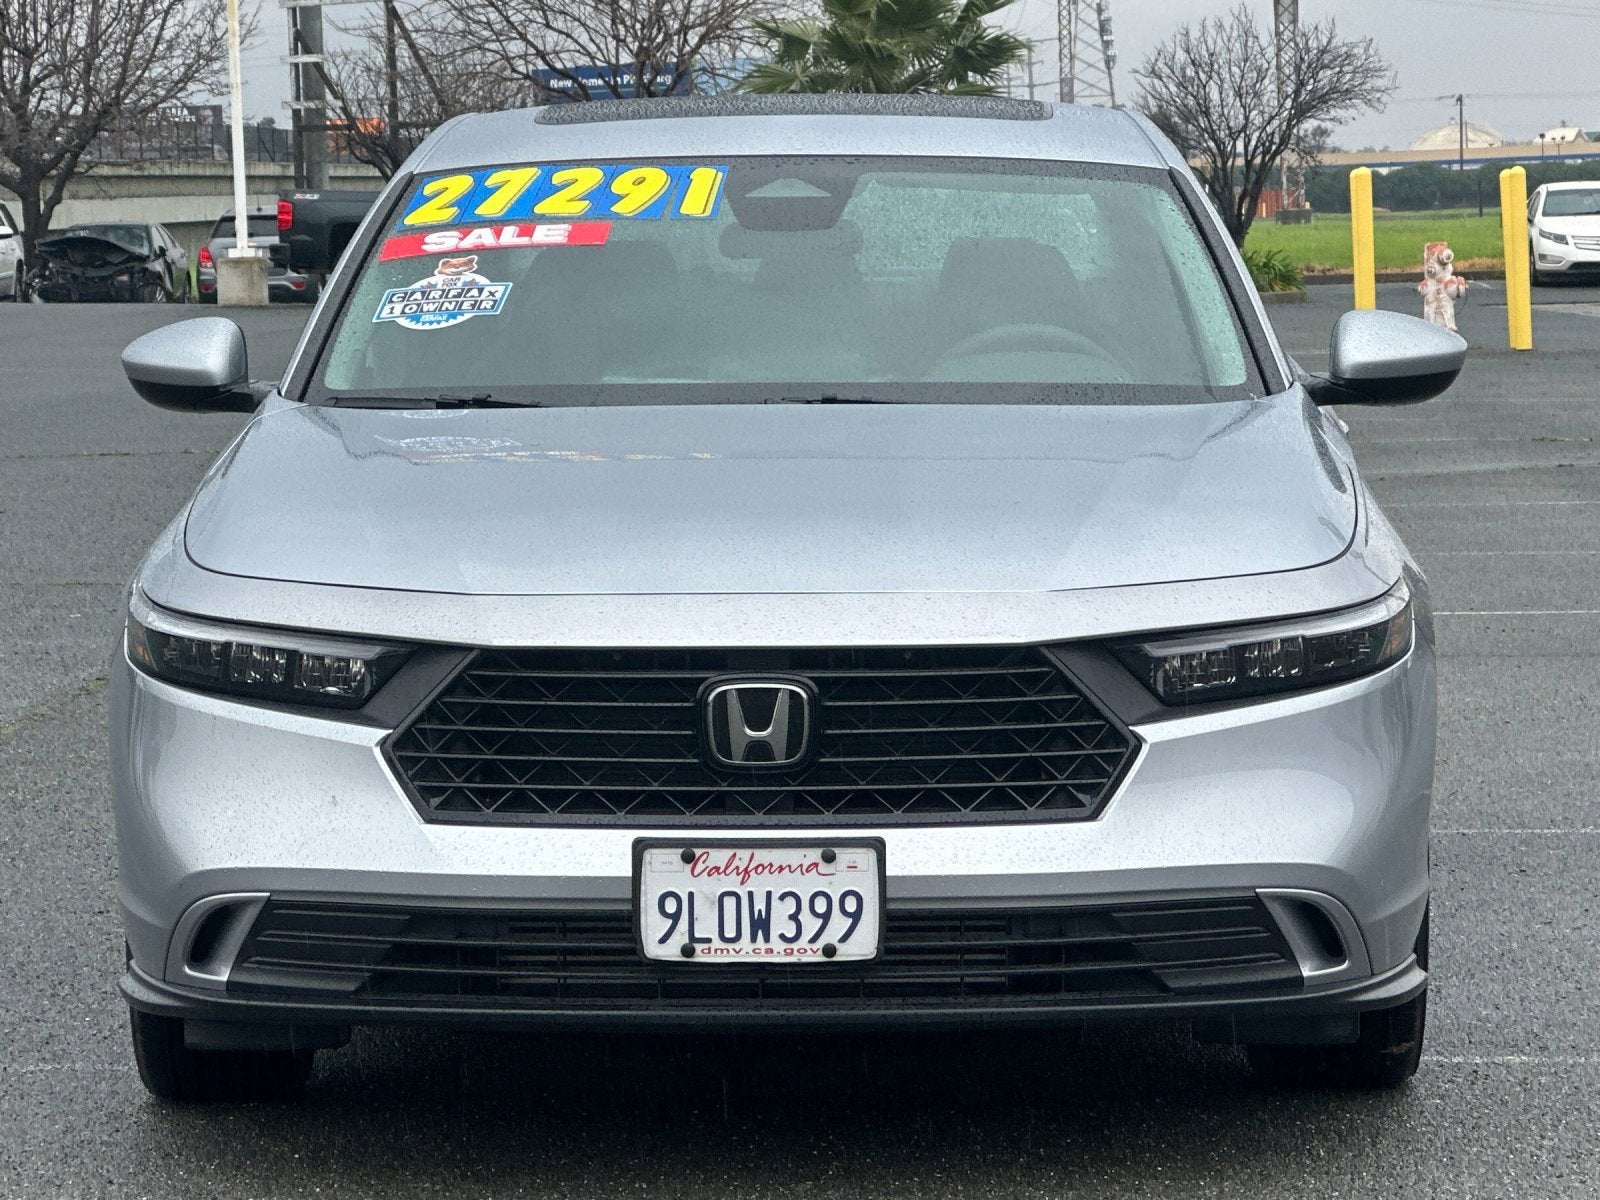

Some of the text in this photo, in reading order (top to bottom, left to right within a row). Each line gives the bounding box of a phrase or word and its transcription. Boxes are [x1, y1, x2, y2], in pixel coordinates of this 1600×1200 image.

[550, 78, 573, 88] New
[403, 167, 722, 225] 27291
[421, 224, 572, 251] SALE
[391, 287, 500, 302] CARFAX
[403, 300, 495, 314] OWNER
[690, 851, 837, 886] California
[658, 889, 864, 945] 9LOW399
[701, 946, 822, 956] dmv.ca.gov
